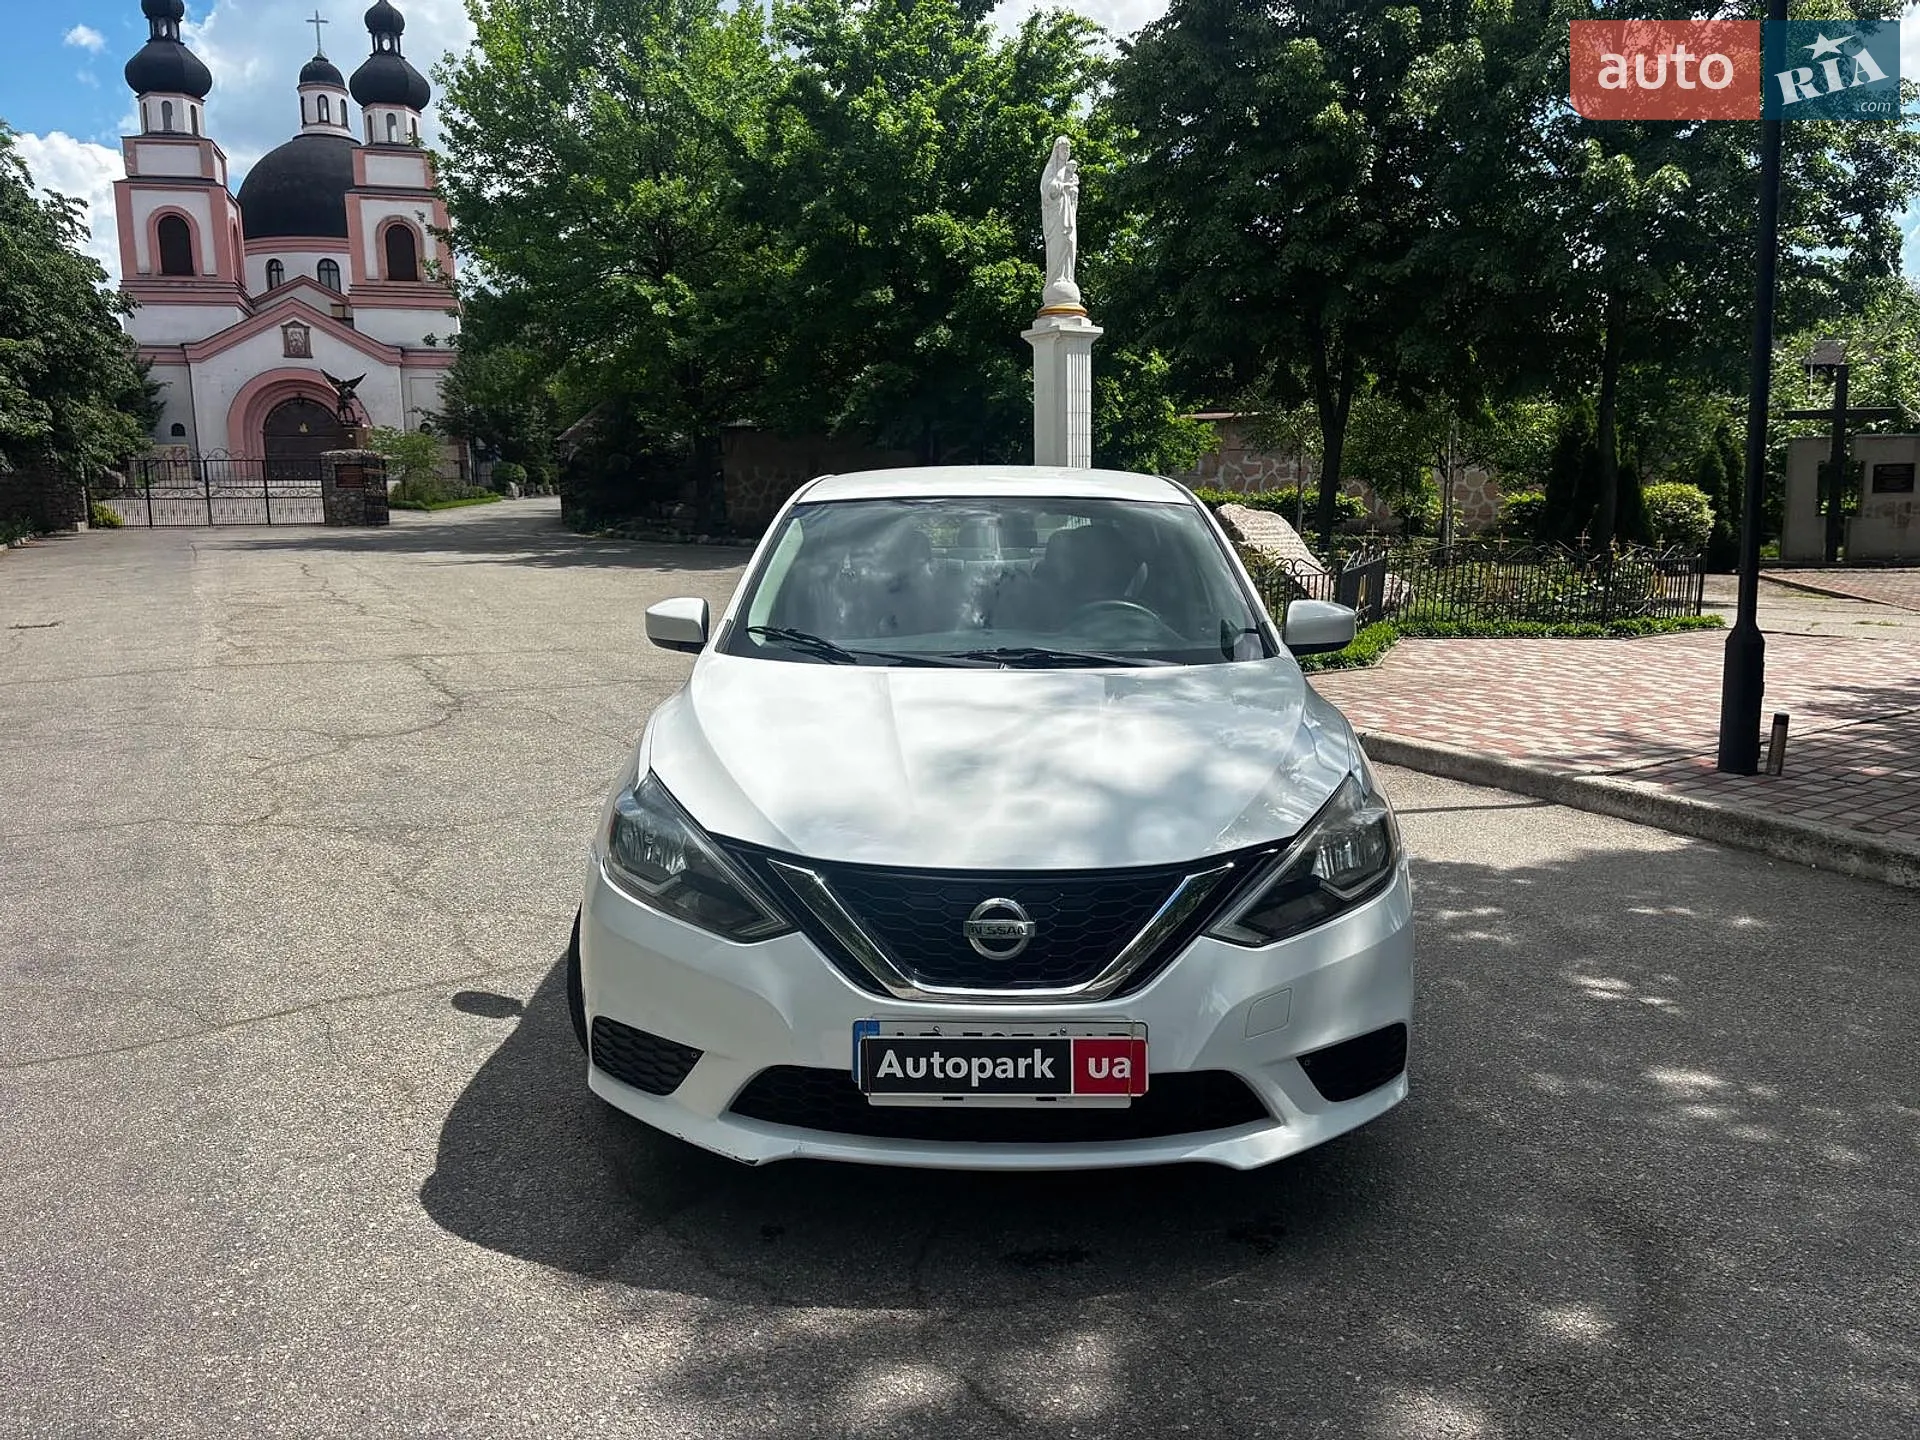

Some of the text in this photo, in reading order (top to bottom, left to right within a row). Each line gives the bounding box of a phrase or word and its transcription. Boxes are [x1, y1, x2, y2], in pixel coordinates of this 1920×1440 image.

[970, 925, 1026, 935] NISSAN
[877, 1048, 1132, 1087] Autopark ua
